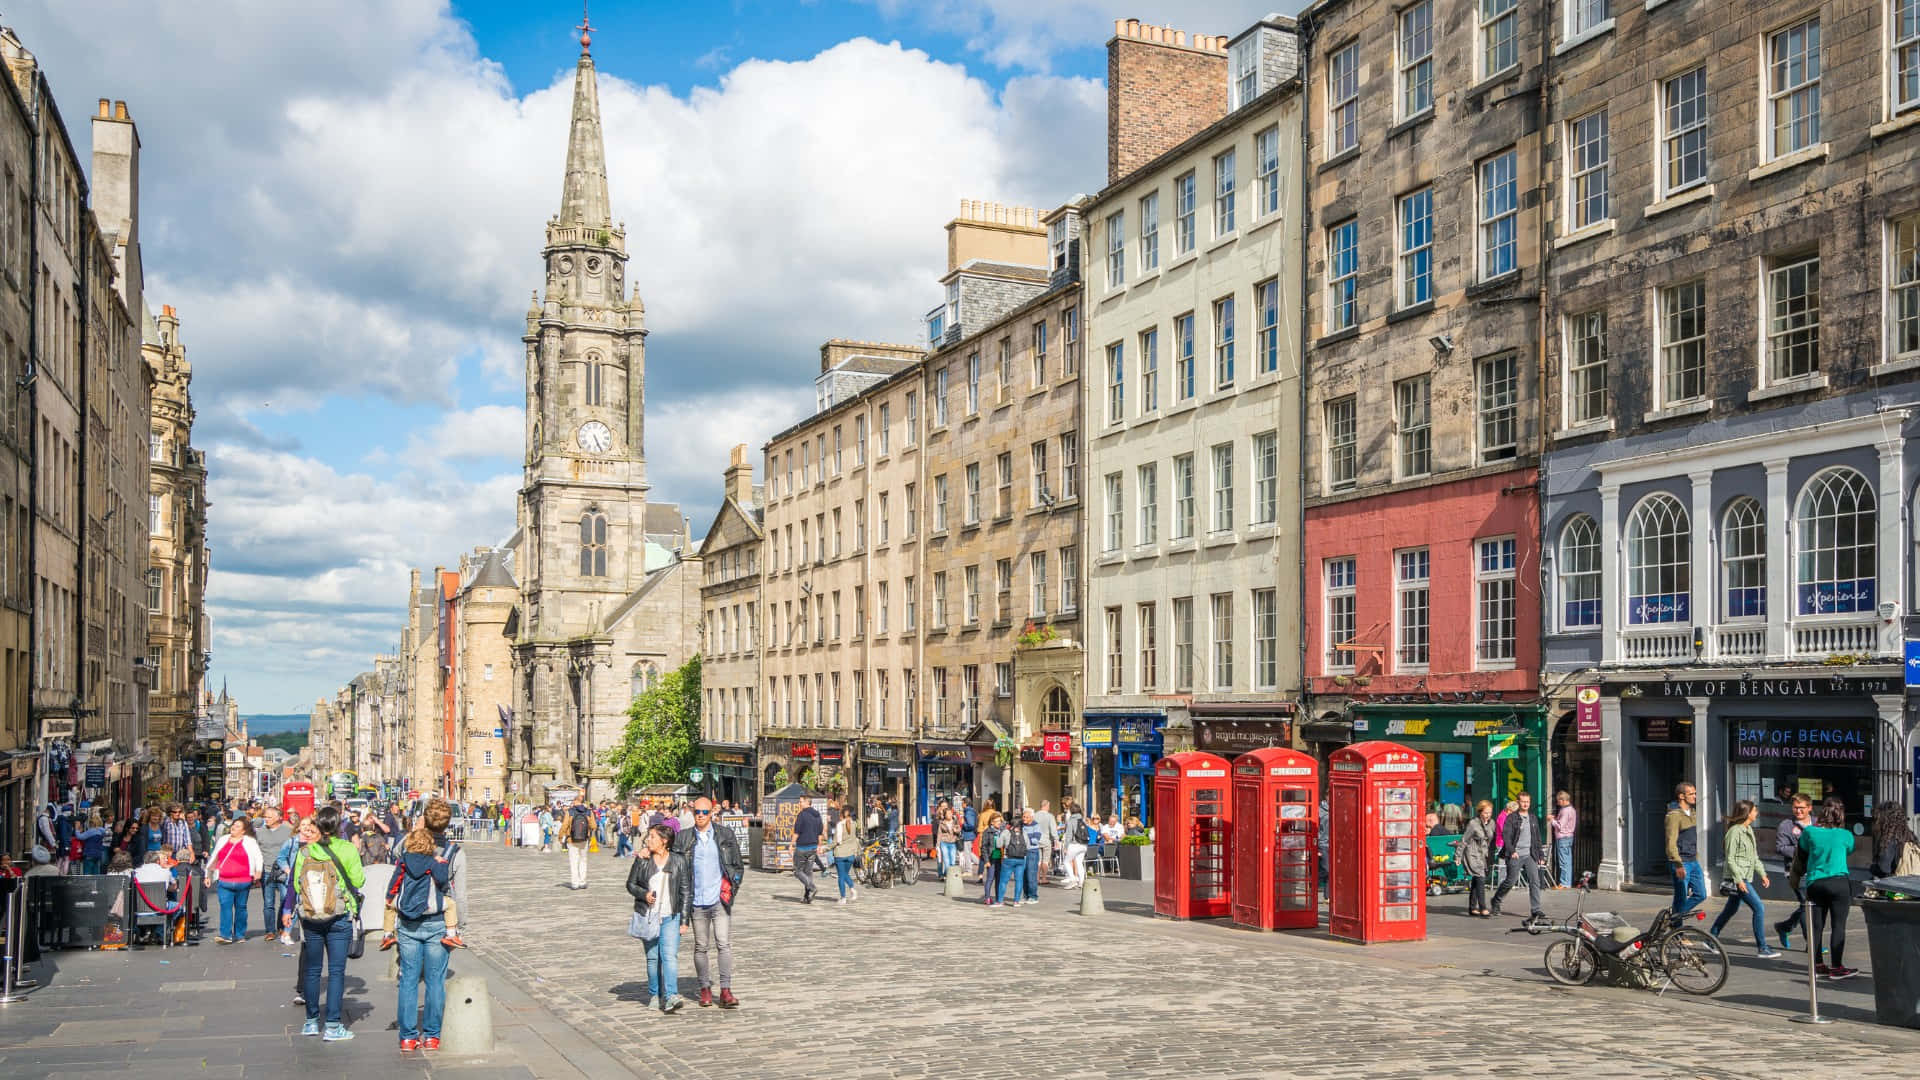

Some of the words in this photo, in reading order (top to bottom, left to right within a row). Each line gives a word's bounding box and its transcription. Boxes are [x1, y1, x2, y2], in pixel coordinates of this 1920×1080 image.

[1664, 682, 1693, 696] BAY
[1705, 682, 1727, 696] OF
[1740, 680, 1817, 696] BENGAL
[1385, 719, 1431, 736] SUBWAY
[1739, 729, 1765, 742] BAY
[1771, 730, 1792, 743] OF
[1798, 729, 1865, 744] BENGAL
[1739, 746, 1780, 757] INDIAN
[1783, 747, 1865, 760] RESTAURANT
